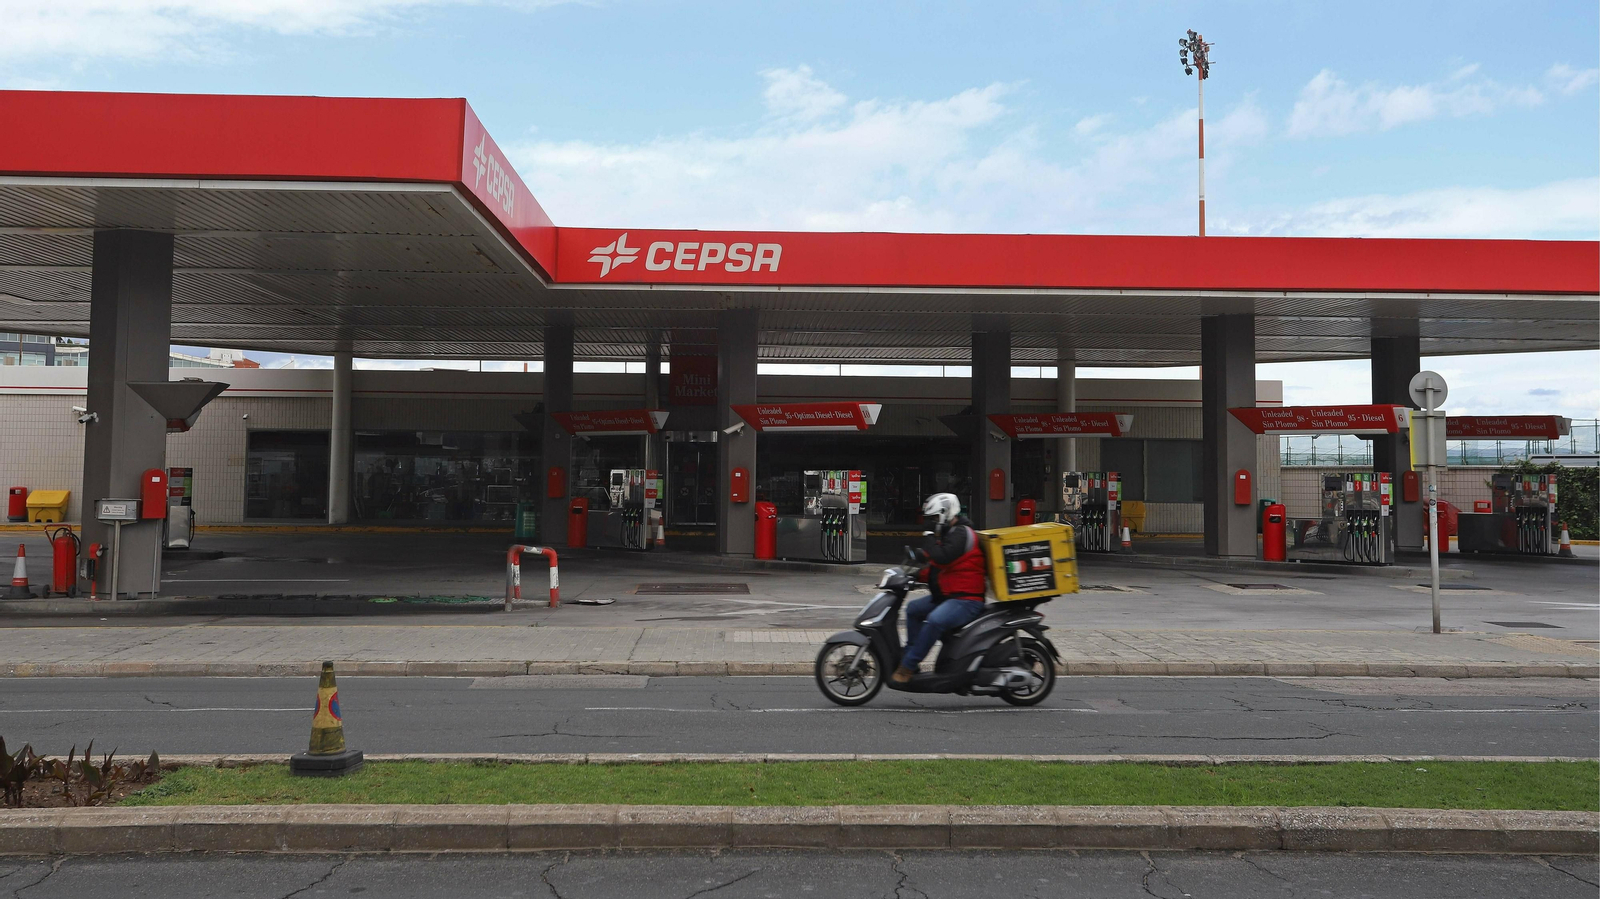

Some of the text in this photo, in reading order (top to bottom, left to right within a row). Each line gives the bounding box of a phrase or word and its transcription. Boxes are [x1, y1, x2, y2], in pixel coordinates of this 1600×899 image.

[486, 154, 514, 218] CEPSA
[645, 241, 783, 272] CEPSA
[683, 374, 710, 384] Mini
[675, 386, 718, 397] Market
[757, 407, 782, 415] Unleaded
[862, 410, 870, 418] 10
[1262, 410, 1293, 418] Unleaded
[1310, 409, 1344, 418] Unleaded
